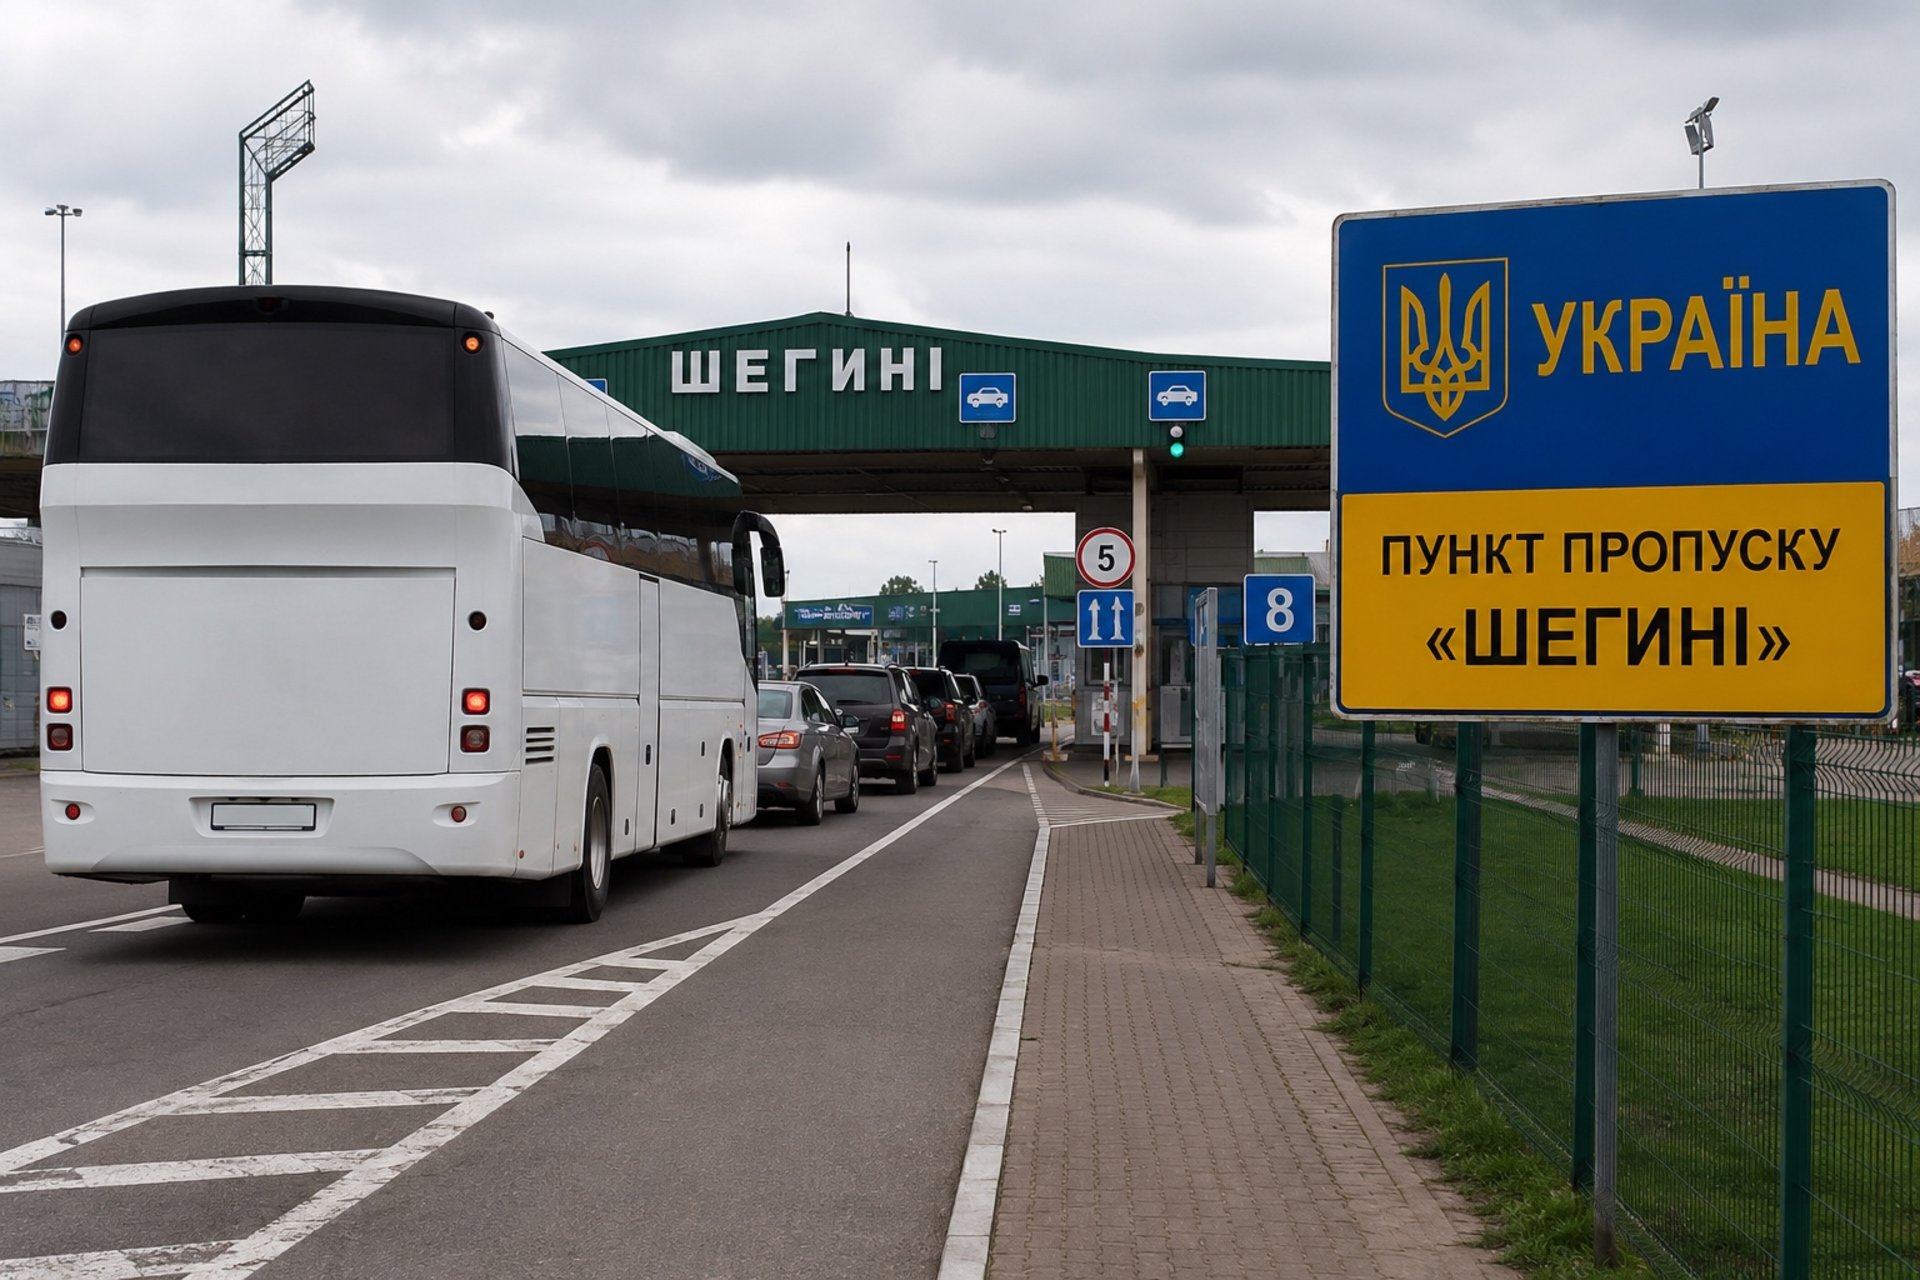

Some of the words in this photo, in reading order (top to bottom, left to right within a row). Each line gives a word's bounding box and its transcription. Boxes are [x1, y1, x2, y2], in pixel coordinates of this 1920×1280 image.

[1532, 276, 1861, 377] УКРАЇНА
[670, 347, 942, 394] ШЕГИНІ
[1098, 545, 1115, 572] 5
[1382, 532, 1544, 576] ПУНКТ
[1563, 527, 1841, 573] ПРОПУСКУ
[1265, 587, 1295, 633] 8
[1426, 605, 1792, 666] «ШЕГИНІ»
